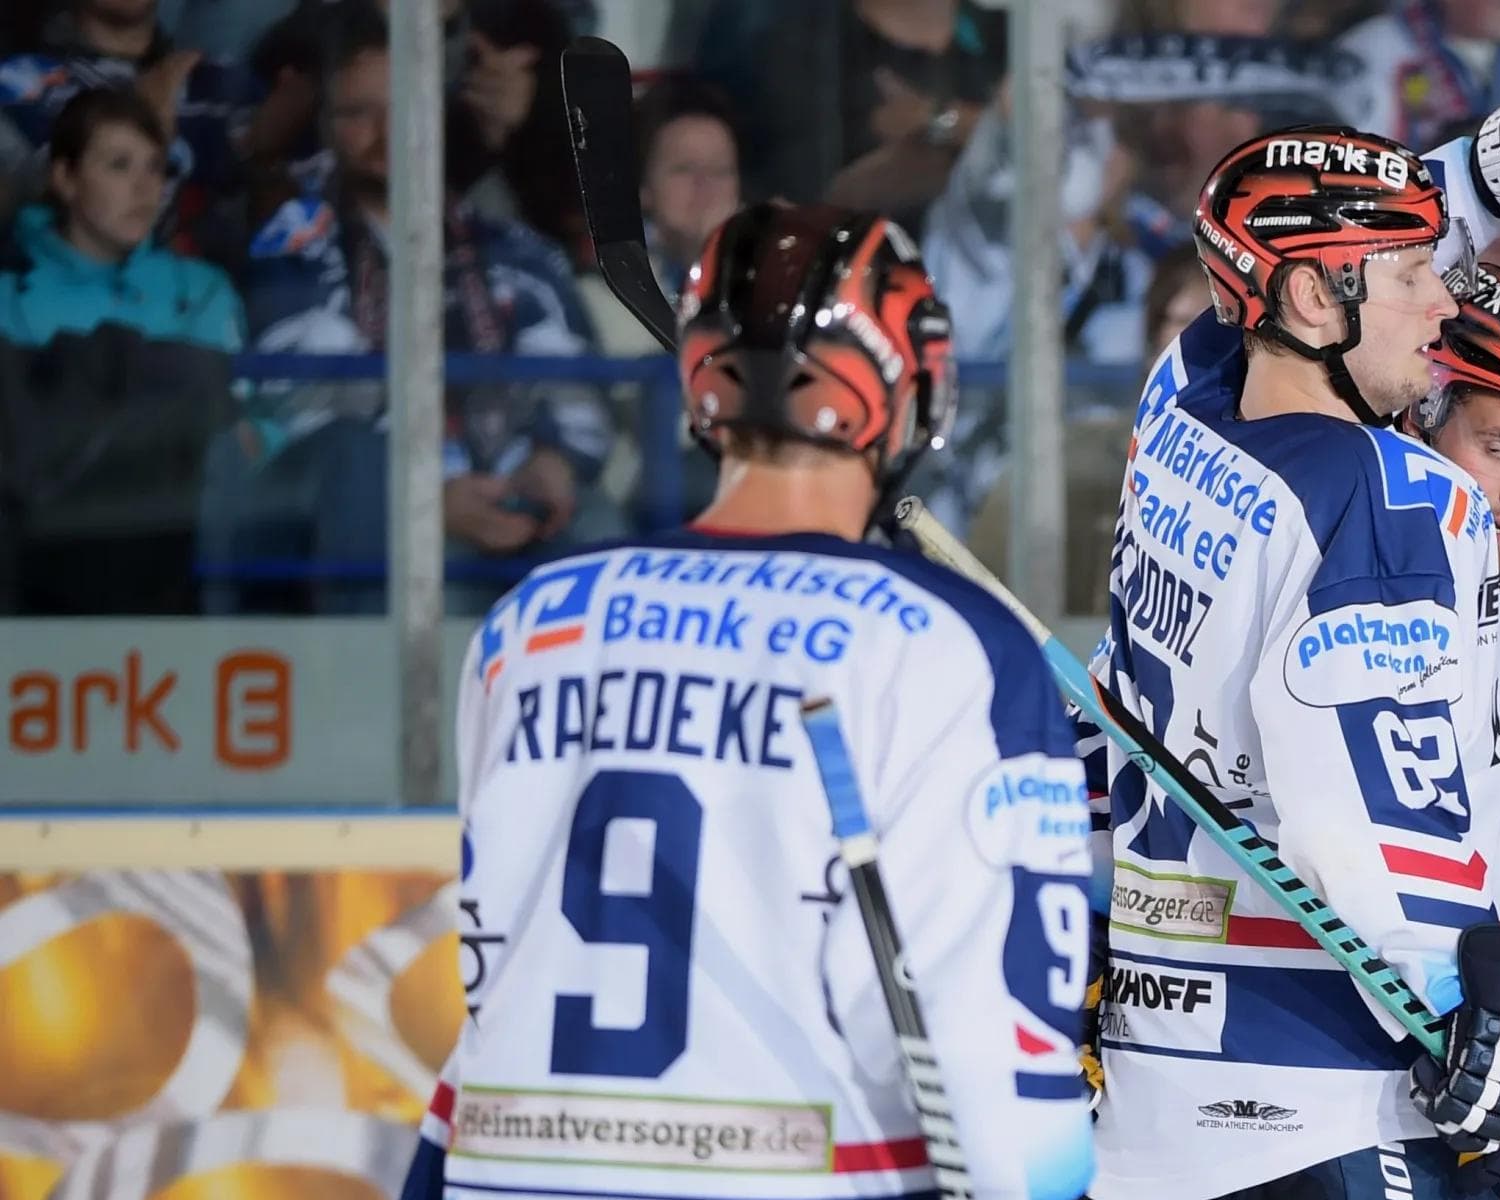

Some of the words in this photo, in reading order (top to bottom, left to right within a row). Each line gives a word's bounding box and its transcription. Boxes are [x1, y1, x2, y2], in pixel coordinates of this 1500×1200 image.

[1266, 140, 1367, 174] mark
[1200, 220, 1237, 258] mark
[1253, 215, 1312, 227] WARRIOR
[1193, 530, 1238, 581] eG
[602, 592, 748, 650] Bank
[767, 616, 853, 664] eG
[617, 550, 933, 634] Märkische
[8, 649, 181, 754] ark
[505, 667, 807, 770] RAEDEKE
[1372, 709, 1468, 816] 62
[550, 768, 705, 1080] 9
[1037, 881, 1091, 1011] 9
[455, 1102, 814, 1160] Heimatversorger.de
[1196, 1120, 1223, 1129] METZEN
[1225, 1121, 1257, 1131] ATHLETIC
